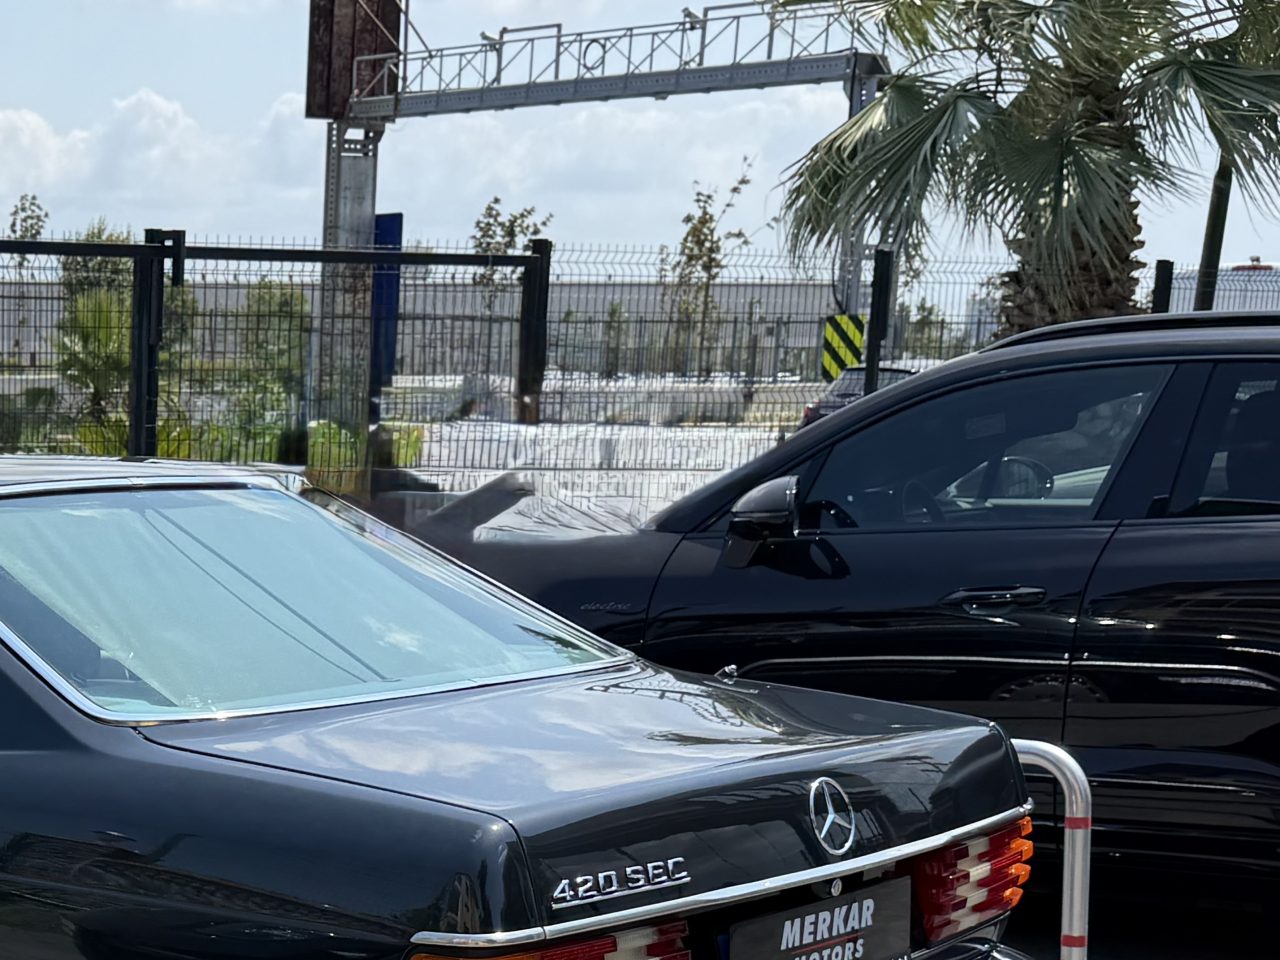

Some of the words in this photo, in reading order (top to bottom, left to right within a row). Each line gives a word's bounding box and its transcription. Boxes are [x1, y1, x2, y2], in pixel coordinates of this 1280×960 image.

[580, 601, 631, 610] electric
[553, 870, 618, 900] 420
[625, 857, 688, 888] SEC
[780, 898, 875, 951] MERKAR
